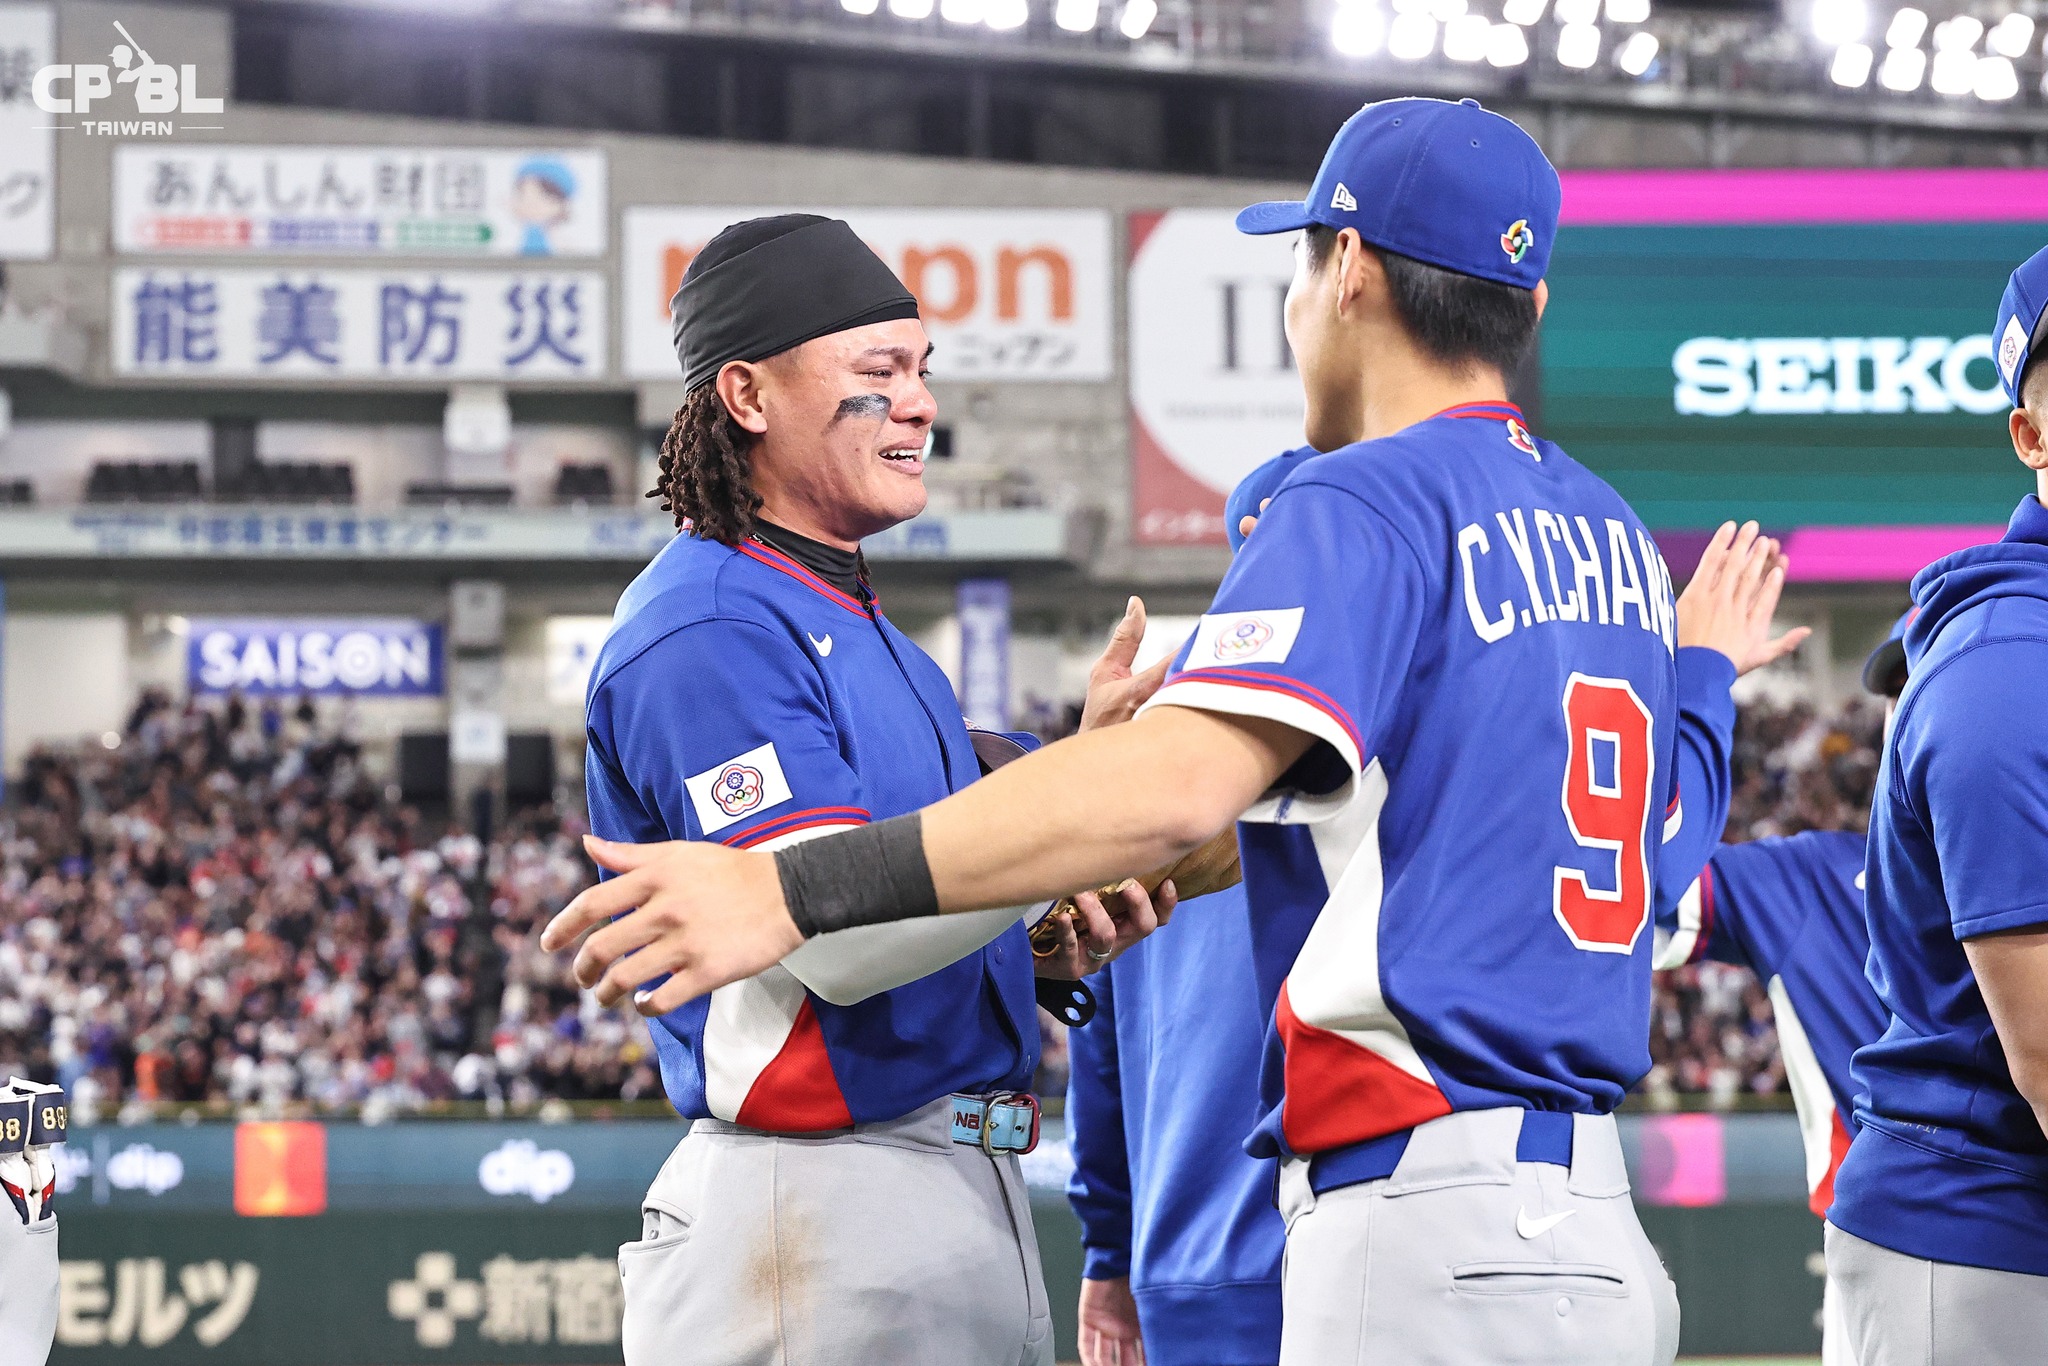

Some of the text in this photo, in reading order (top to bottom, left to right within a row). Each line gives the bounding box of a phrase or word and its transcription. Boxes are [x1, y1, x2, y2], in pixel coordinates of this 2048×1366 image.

[132, 279, 586, 367] 能美防災
[1672, 337, 2012, 416] SEIKO
[200, 631, 431, 689] SAISON
[1553, 671, 1654, 955] 9
[57, 1257, 259, 1347] モルツ
